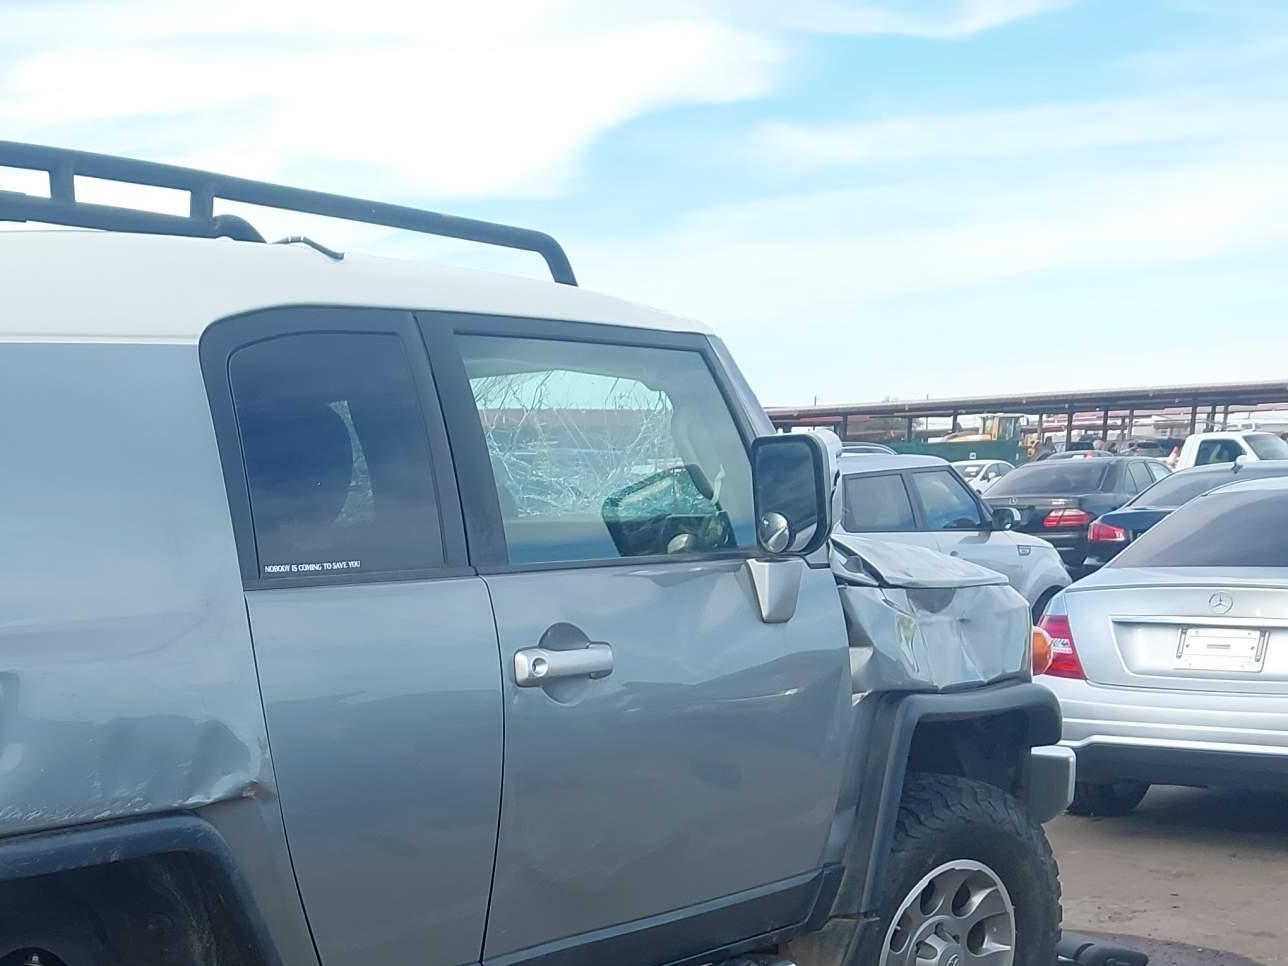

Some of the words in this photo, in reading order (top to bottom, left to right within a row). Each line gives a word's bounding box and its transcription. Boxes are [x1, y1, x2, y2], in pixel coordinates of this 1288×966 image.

[264, 565, 291, 573] NOBODY
[291, 564, 298, 572] IS
[298, 563, 322, 571] COMING
[323, 562, 332, 570] TO
[332, 561, 348, 569] SAVE
[348, 560, 361, 568] YOU
